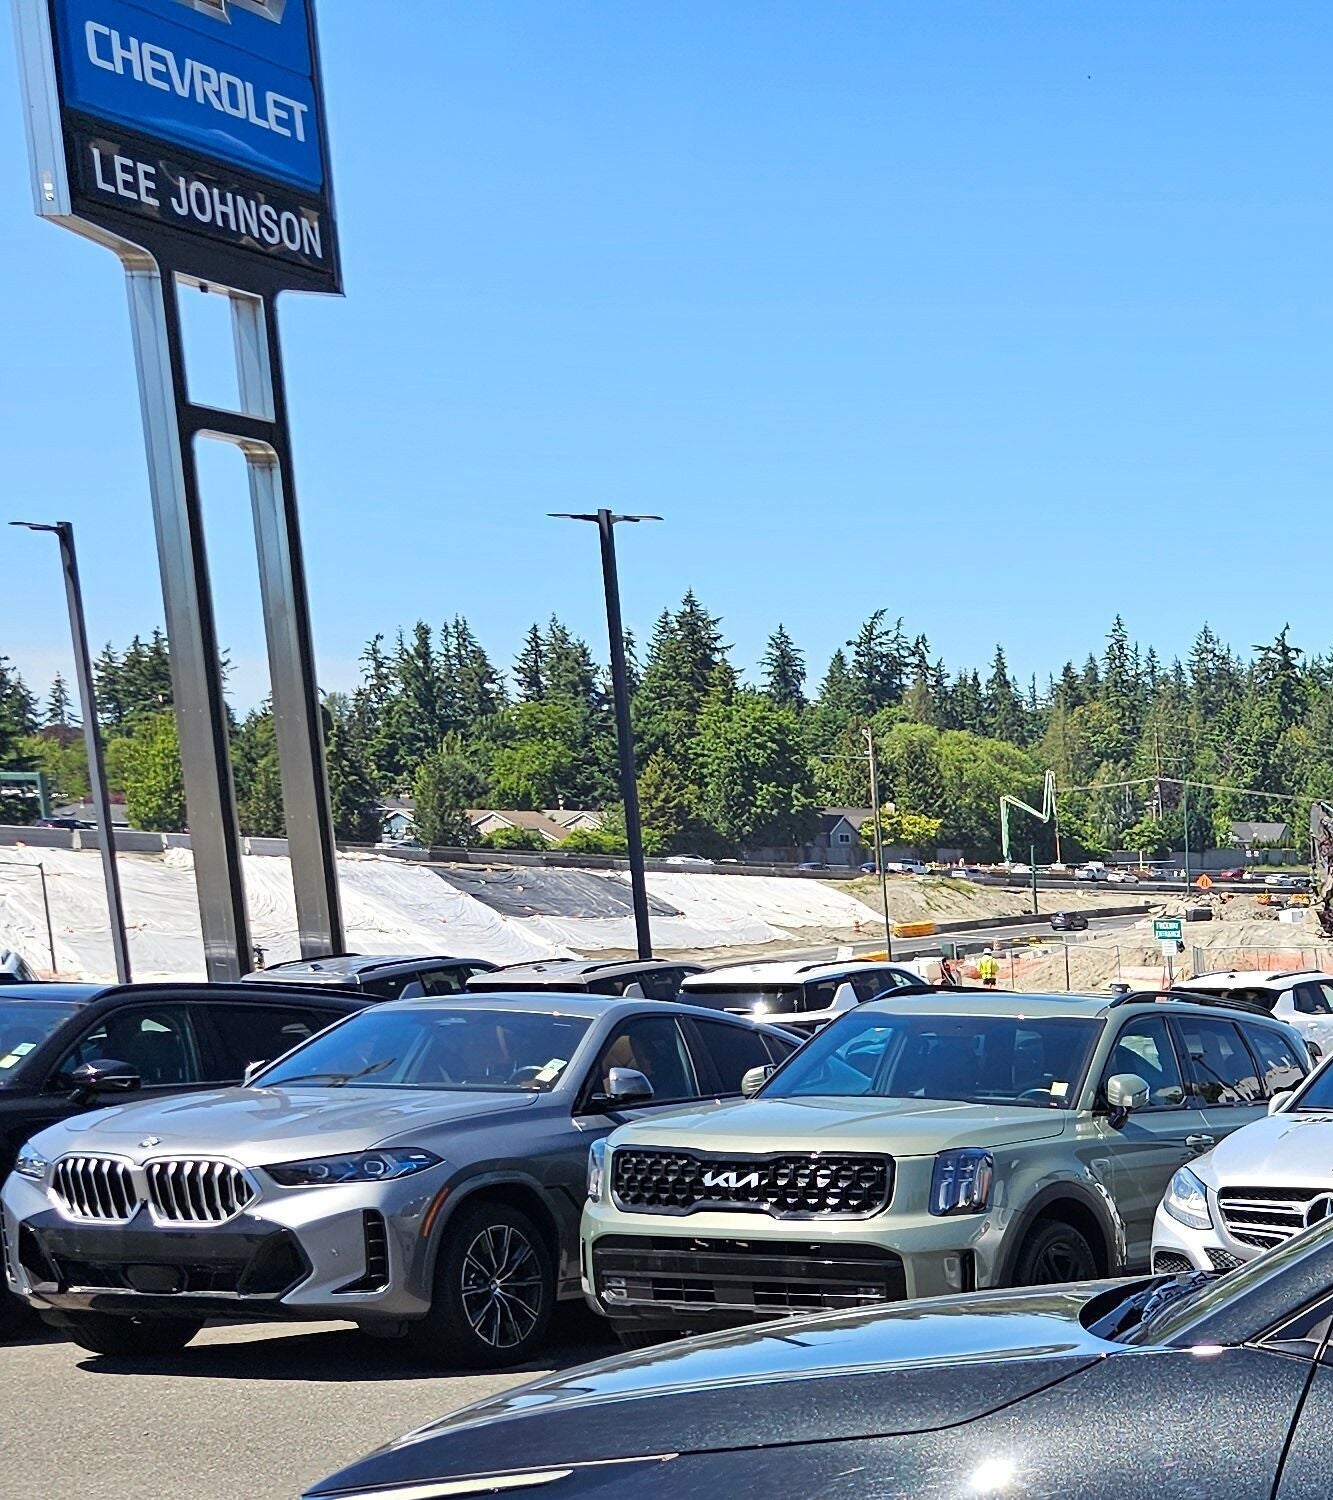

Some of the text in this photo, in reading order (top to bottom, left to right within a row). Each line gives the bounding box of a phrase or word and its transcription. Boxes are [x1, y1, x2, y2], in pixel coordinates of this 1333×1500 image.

[85, 20, 309, 142] CHEVROLET
[91, 147, 323, 259] LEE JOHNSON
[702, 1170, 759, 1189] KIA
